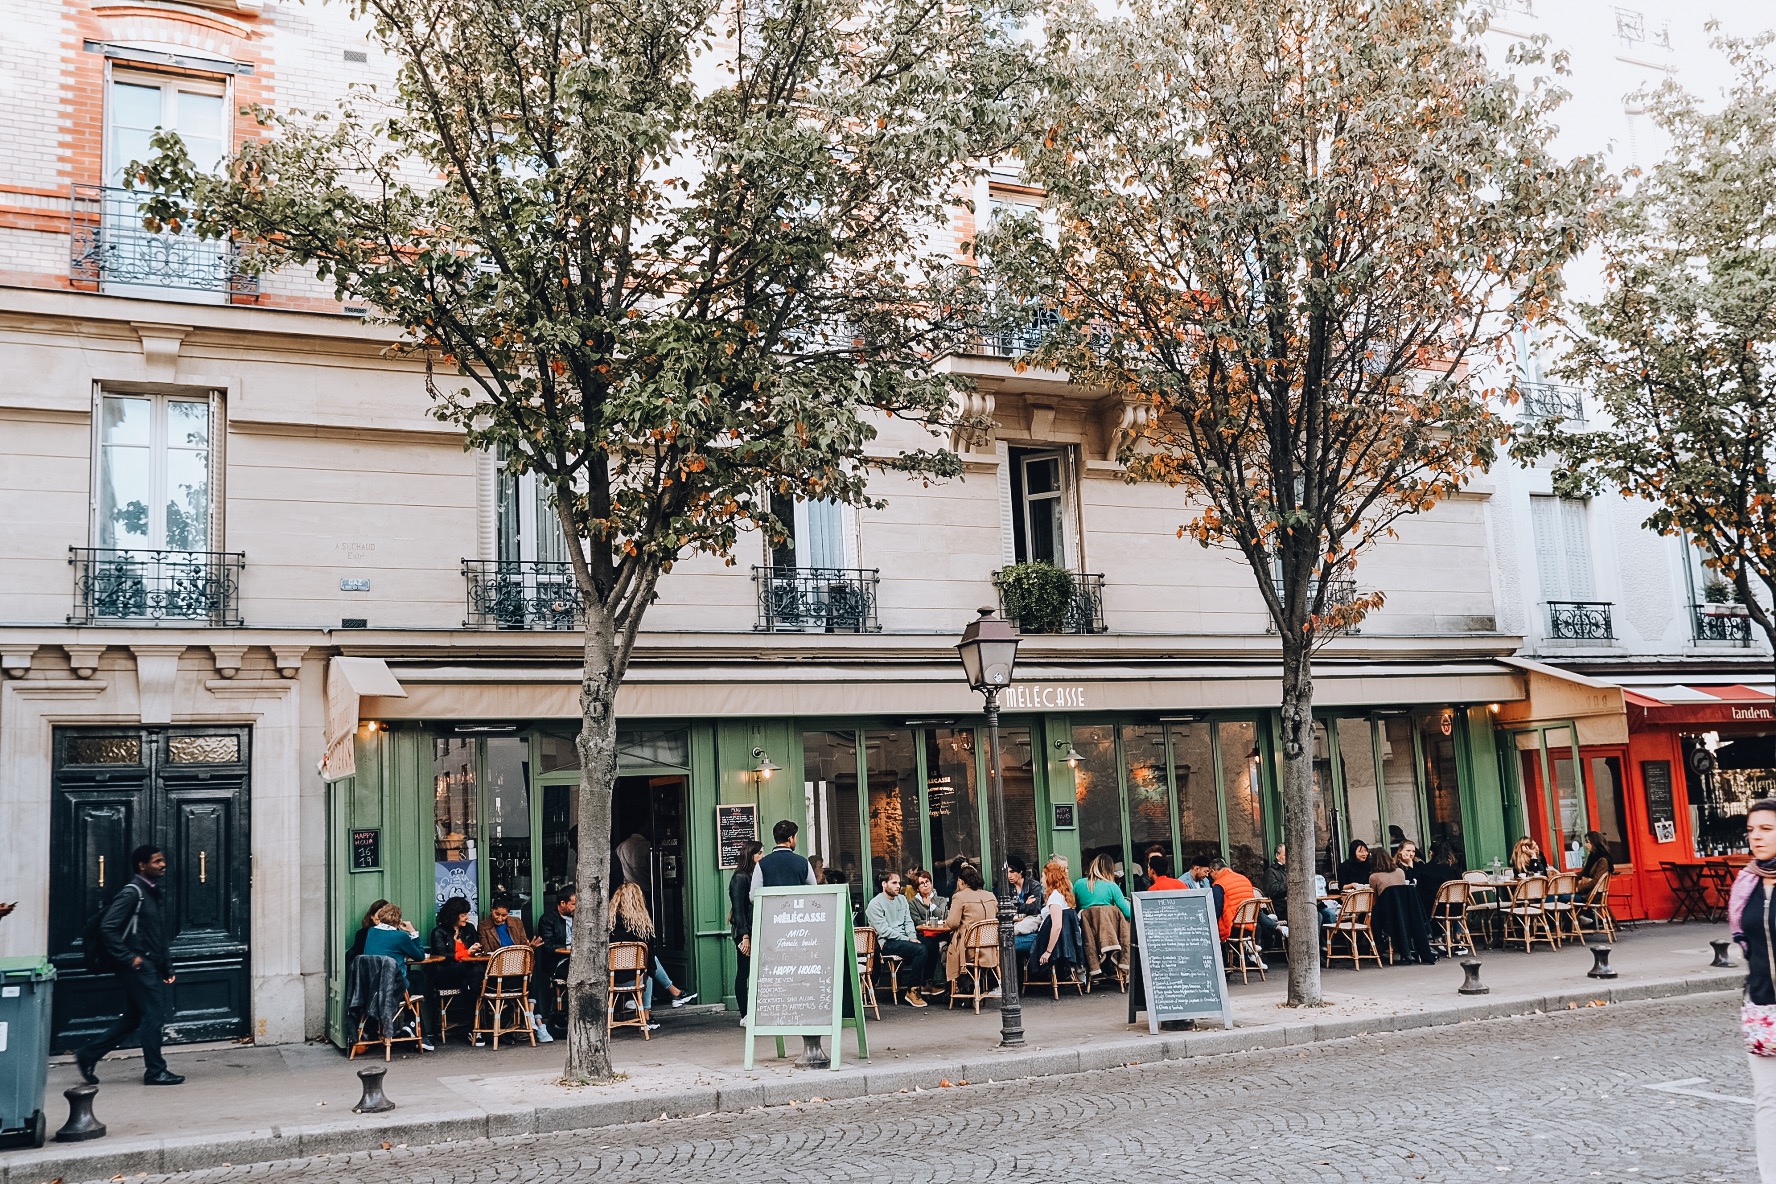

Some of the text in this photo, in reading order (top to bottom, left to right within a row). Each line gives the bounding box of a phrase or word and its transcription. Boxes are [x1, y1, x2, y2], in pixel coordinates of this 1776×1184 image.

[793, 899, 805, 908] LE
[772, 964, 822, 975] HAPPY HOURS
[759, 1004, 781, 1012] PINTE
